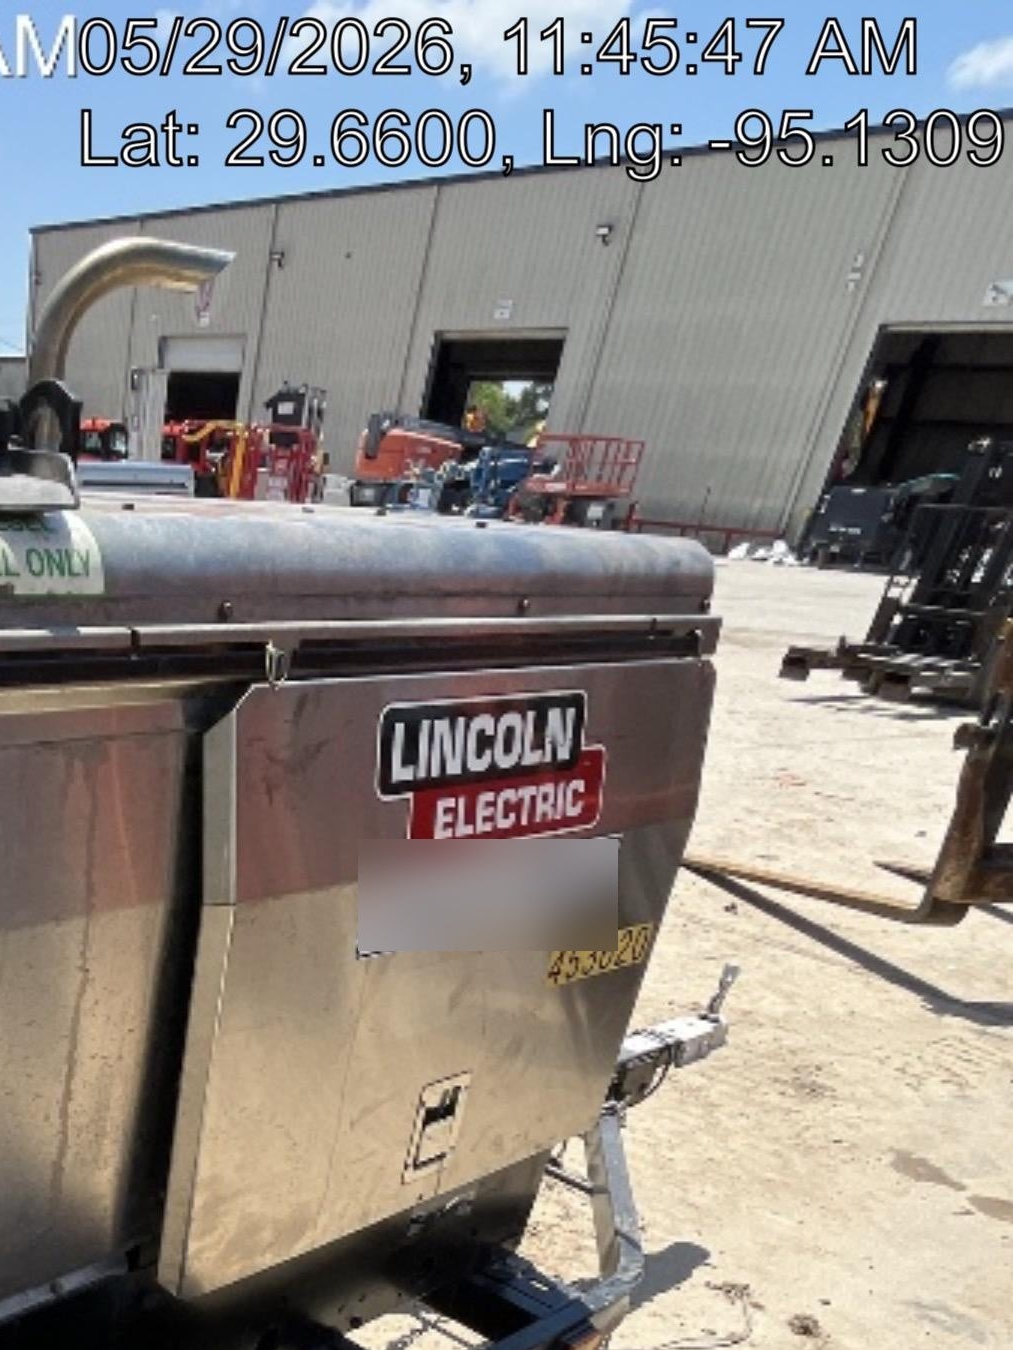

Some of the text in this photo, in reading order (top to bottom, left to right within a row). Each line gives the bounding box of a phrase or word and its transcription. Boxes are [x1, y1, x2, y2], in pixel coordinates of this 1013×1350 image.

[26, 546, 91, 578] ONLY
[391, 707, 577, 784] LINCOLN
[434, 778, 586, 840] ELECTRIC
